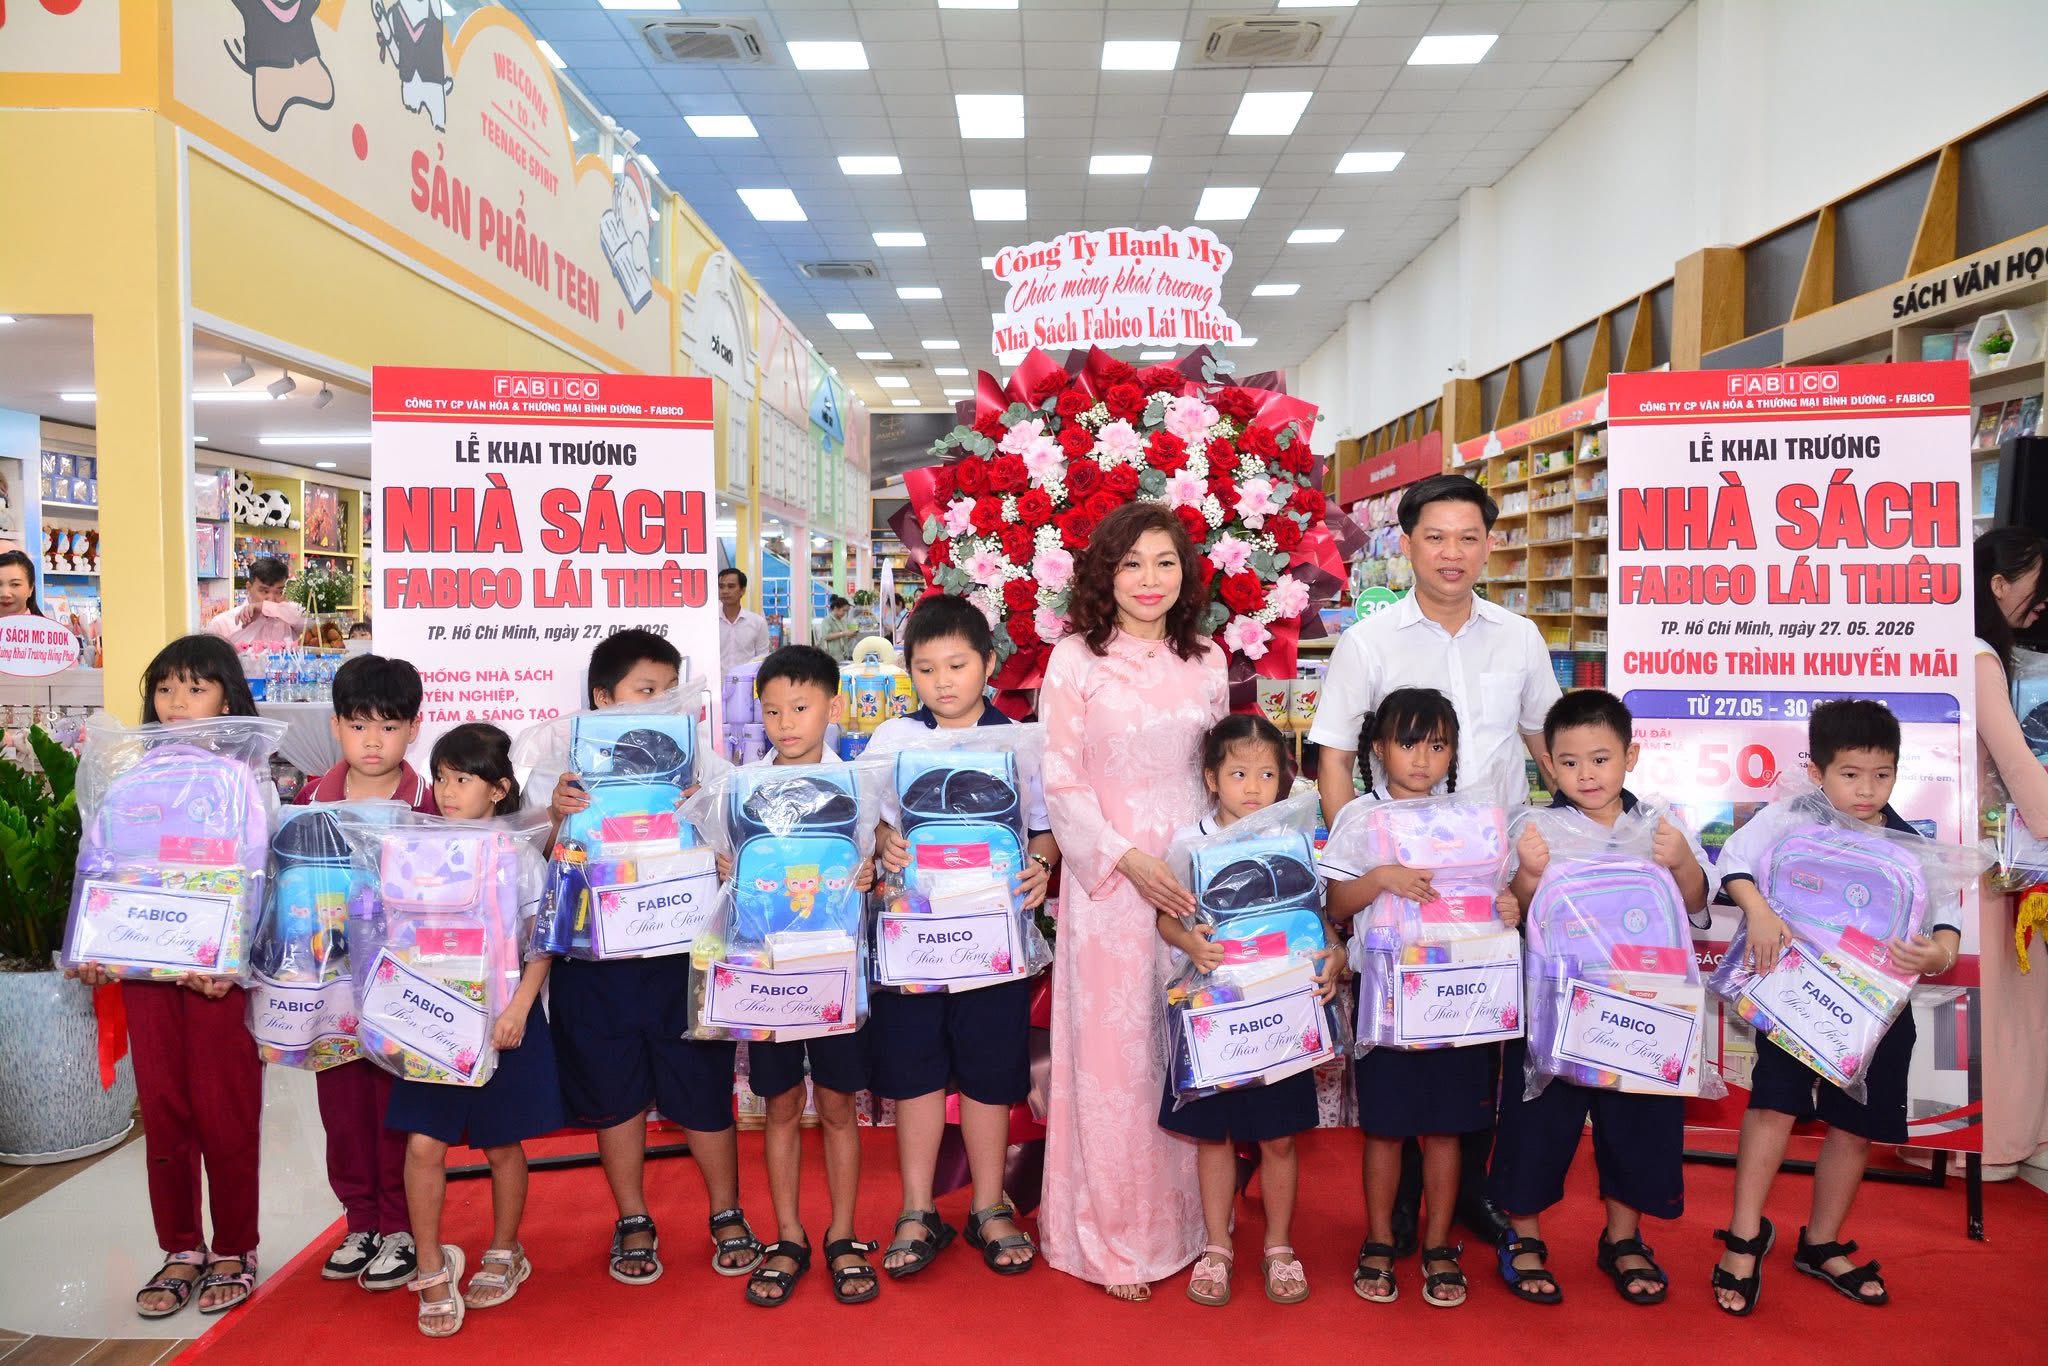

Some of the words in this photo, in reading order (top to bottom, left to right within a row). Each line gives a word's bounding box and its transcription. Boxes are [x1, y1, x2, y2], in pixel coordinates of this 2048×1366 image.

[494, 52, 548, 127] WELCOME
[518, 101, 528, 125] to
[481, 111, 527, 170] TEENAGE
[529, 154, 559, 196] SPIRIT
[411, 142, 471, 240] SẢN
[480, 190, 549, 291] PHẨM
[555, 251, 599, 323] TEEN
[994, 242, 1062, 279] Công
[1069, 234, 1100, 266] Ty
[1109, 231, 1179, 265] Hạnh
[1188, 236, 1226, 272] My
[1012, 273, 1057, 313] Chúc
[1061, 269, 1109, 305] mừng
[1112, 265, 1153, 295] khai
[1893, 280, 1947, 318] SÁCH
[1953, 261, 2000, 297] VĂN
[2007, 247, 2048, 280] HỌ
[995, 317, 1029, 354] Nhà
[1034, 312, 1077, 346] Sách
[1082, 306, 1143, 341] Fabico
[1147, 306, 1178, 338] Lái
[1181, 307, 1234, 342] Thiêu
[497, 379, 598, 397] FABICO
[1730, 375, 1837, 392] FABICO
[405, 397, 432, 409] CÔNG
[435, 399, 447, 409] TY
[450, 400, 464, 409] CP
[466, 399, 486, 410] VĂN
[489, 399, 509, 411] HÓA
[512, 402, 520, 411] &
[522, 401, 560, 412] THƯƠNG
[563, 403, 581, 414] MẠI
[584, 402, 607, 413] BÌNH
[610, 403, 642, 414] DƯƠNG
[650, 406, 684, 416] FABICO
[1640, 399, 1666, 412] CÔNG
[1668, 401, 1681, 411] TY
[1683, 401, 1697, 411] CP
[1699, 399, 1720, 410] VĂN
[1722, 397, 1744, 409] HÓA
[1746, 400, 1754, 409] &
[1756, 398, 1797, 409] THƯƠNG
[1800, 397, 1819, 408] MẠI
[1822, 395, 1847, 406] BÌNH
[1850, 395, 1886, 405] DƯƠNG
[1896, 393, 1935, 404] FABICO
[455, 432, 480, 463] LỄ
[488, 441, 542, 464] KHAI
[549, 440, 637, 466] TRƯƠNG
[1689, 433, 1714, 463] LỄ
[1721, 439, 1777, 462] KHAI
[1784, 434, 1880, 460] TRƯƠNG
[383, 473, 523, 553] NHÀ
[540, 474, 707, 555] SÁCH
[1619, 470, 1757, 551] NHÀ
[1775, 468, 1961, 550] SÁCH
[383, 567, 521, 609] FABICO
[533, 559, 592, 608] LÁI
[602, 560, 708, 609] THIÊU
[1619, 563, 1756, 605] FABICO
[1767, 555, 1830, 604] LÁI
[1841, 554, 1961, 605] THIÊU
[6, 626, 28, 643] SÁCH
[32, 630, 45, 644] MC
[48, 632, 69, 645] BOOK
[428, 626, 447, 640] TP.
[452, 623, 471, 640] Hồ
[475, 624, 498, 640] Chi
[501, 624, 540, 641] Minh,
[544, 625, 579, 642] ngày
[583, 624, 603, 639] 27.
[1661, 621, 1679, 635] TP.
[1684, 619, 1704, 635] Hồ
[1707, 621, 1731, 635] Chi
[1734, 621, 1773, 637] Minh,
[1778, 621, 1816, 638] ngày
[1819, 621, 1841, 636] 27.
[1846, 621, 1870, 636] 05.
[1875, 621, 1915, 636] 2026
[1623, 648, 1718, 676] CHƯƠNG
[1725, 647, 1795, 675] TRÌNH
[1803, 647, 1901, 676] KHUYẾN
[1910, 649, 1958, 677] MÃI
[476, 668, 509, 682] NHÀ
[515, 667, 553, 681] SÁCH
[459, 688, 519, 703] NGHIỆP,
[1687, 694, 1711, 715] TỪ
[1715, 698, 1763, 716] 27.05
[429, 710, 461, 722] TÂM
[466, 710, 476, 721] &
[482, 707, 525, 721] SÁNG
[529, 708, 559, 722] TẠO
[637, 892, 692, 912] FABICO
[128, 907, 187, 923] FABICO
[918, 930, 973, 944] FABICO
[750, 984, 808, 996] FABICO
[1437, 982, 1487, 997] FABICO
[269, 998, 325, 1013] FABICO
[402, 989, 455, 1023] FABICO
[1801, 980, 1853, 1025] FABICO
[1229, 1013, 1284, 1036] FABICO
[1600, 1010, 1656, 1035] FABICO
